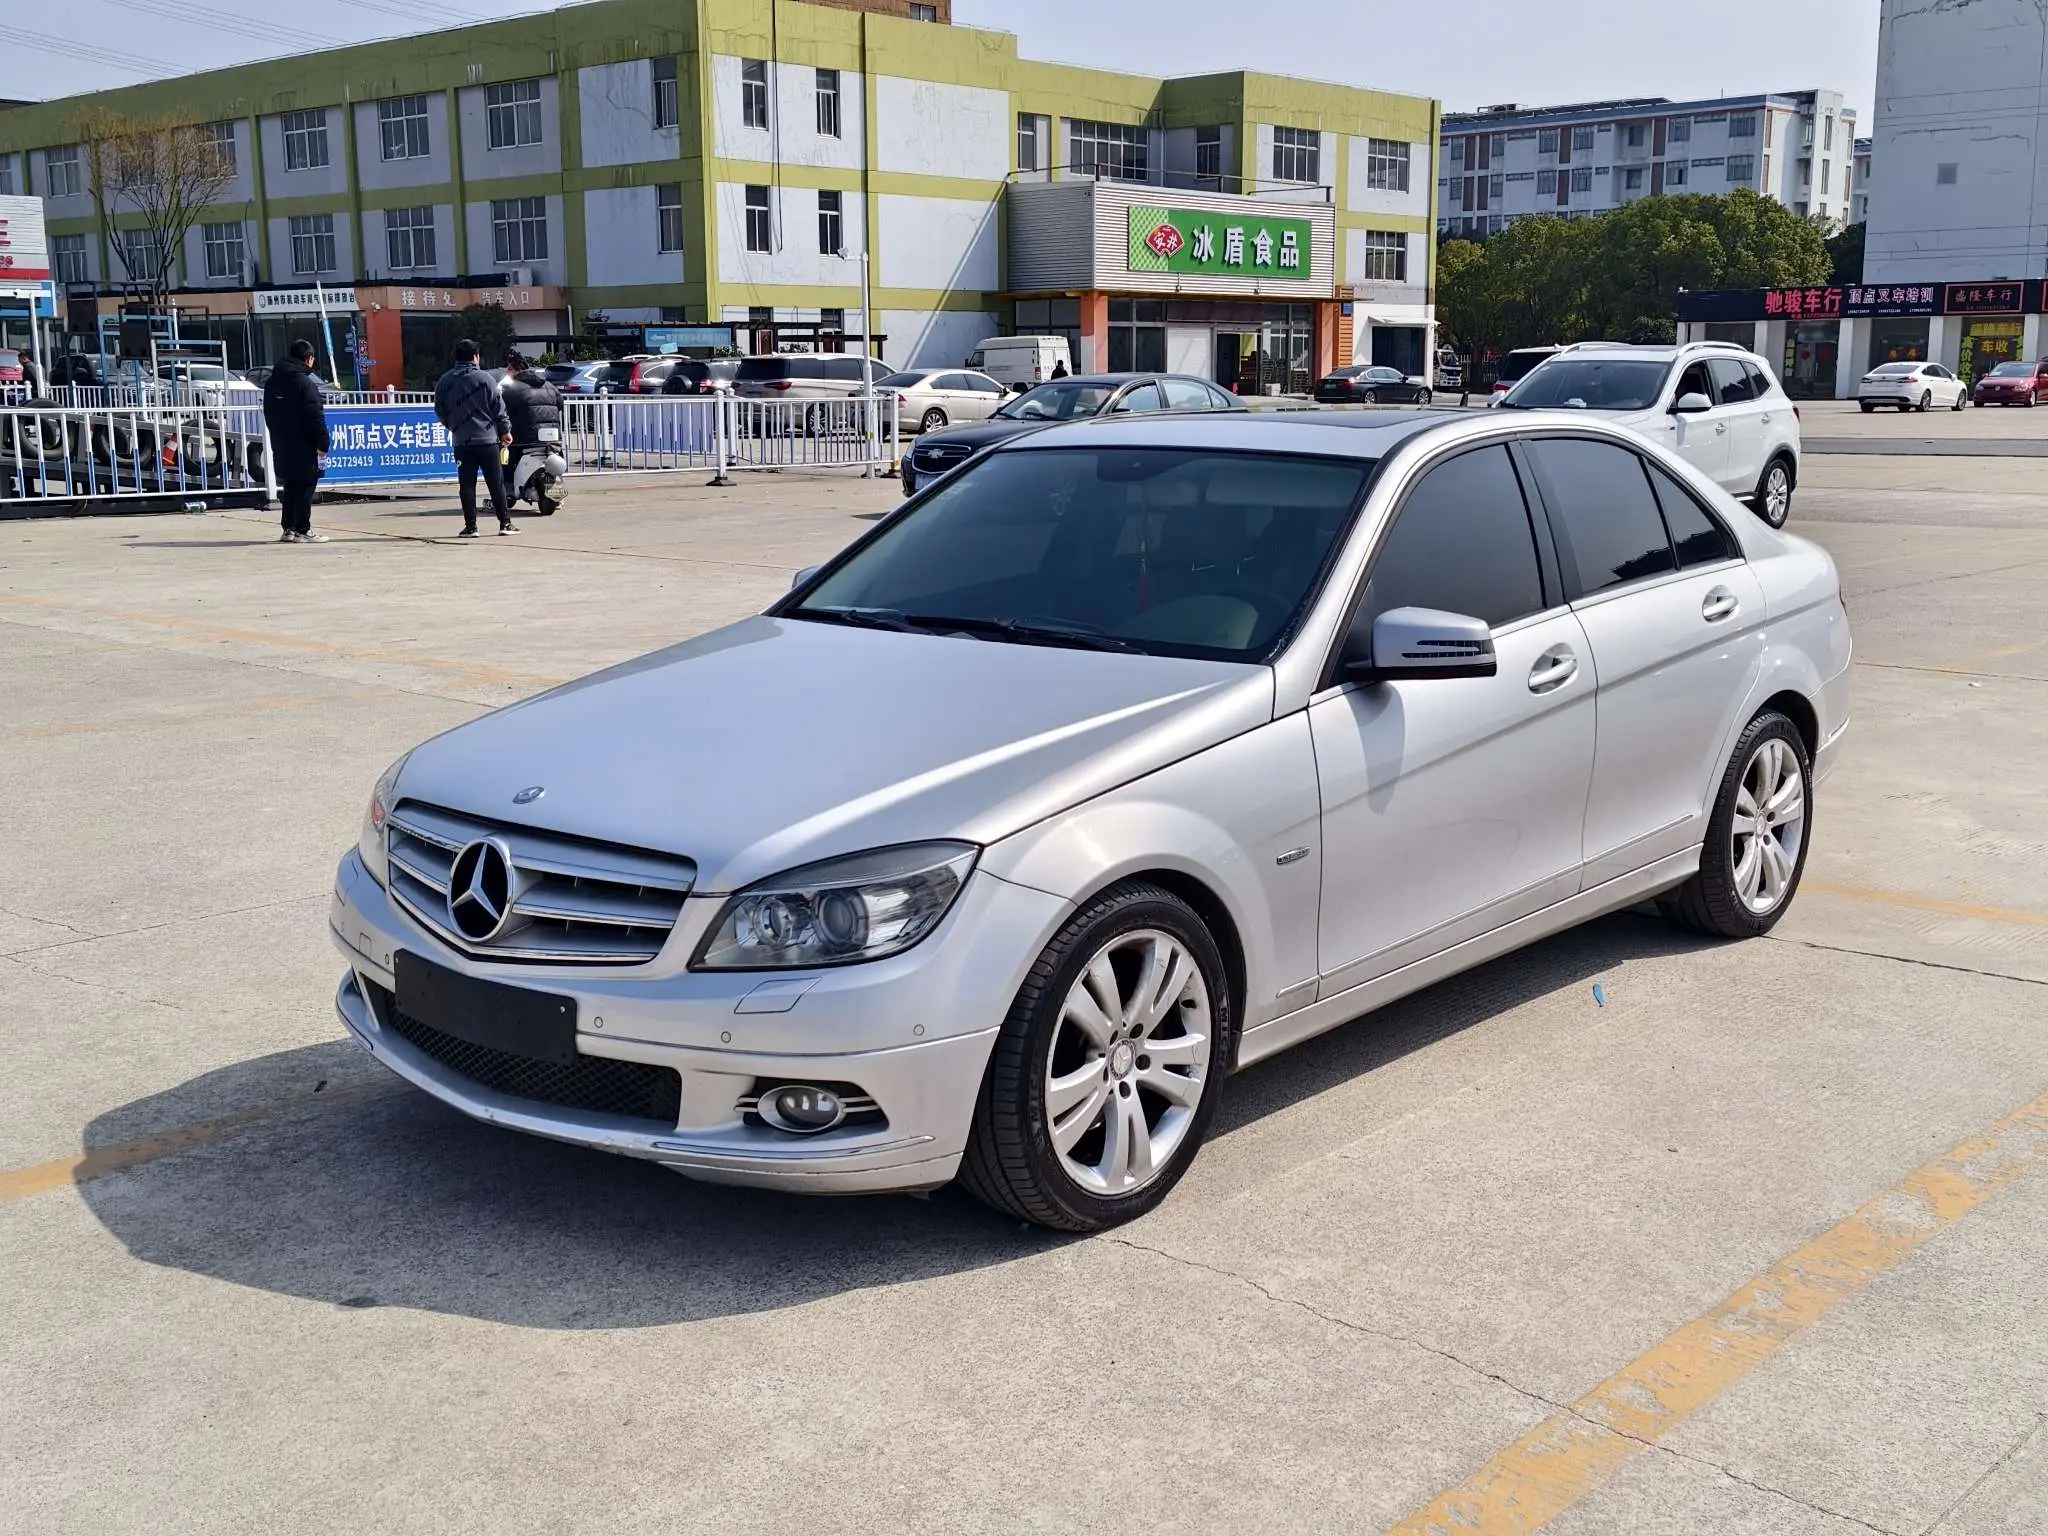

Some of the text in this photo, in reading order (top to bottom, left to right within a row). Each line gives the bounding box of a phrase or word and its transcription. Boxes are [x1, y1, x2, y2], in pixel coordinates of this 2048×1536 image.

[1153, 231, 1178, 251] 安井
[1192, 224, 1300, 268] 冰盾食品
[401, 288, 457, 306] 接待处
[1764, 287, 1842, 314] 驰骏车行
[1848, 286, 1934, 304] 顶点叉车培训
[329, 422, 453, 450] 州顶点叉车起重
[326, 455, 373, 468] 952729419
[380, 453, 435, 466] 13382722188
